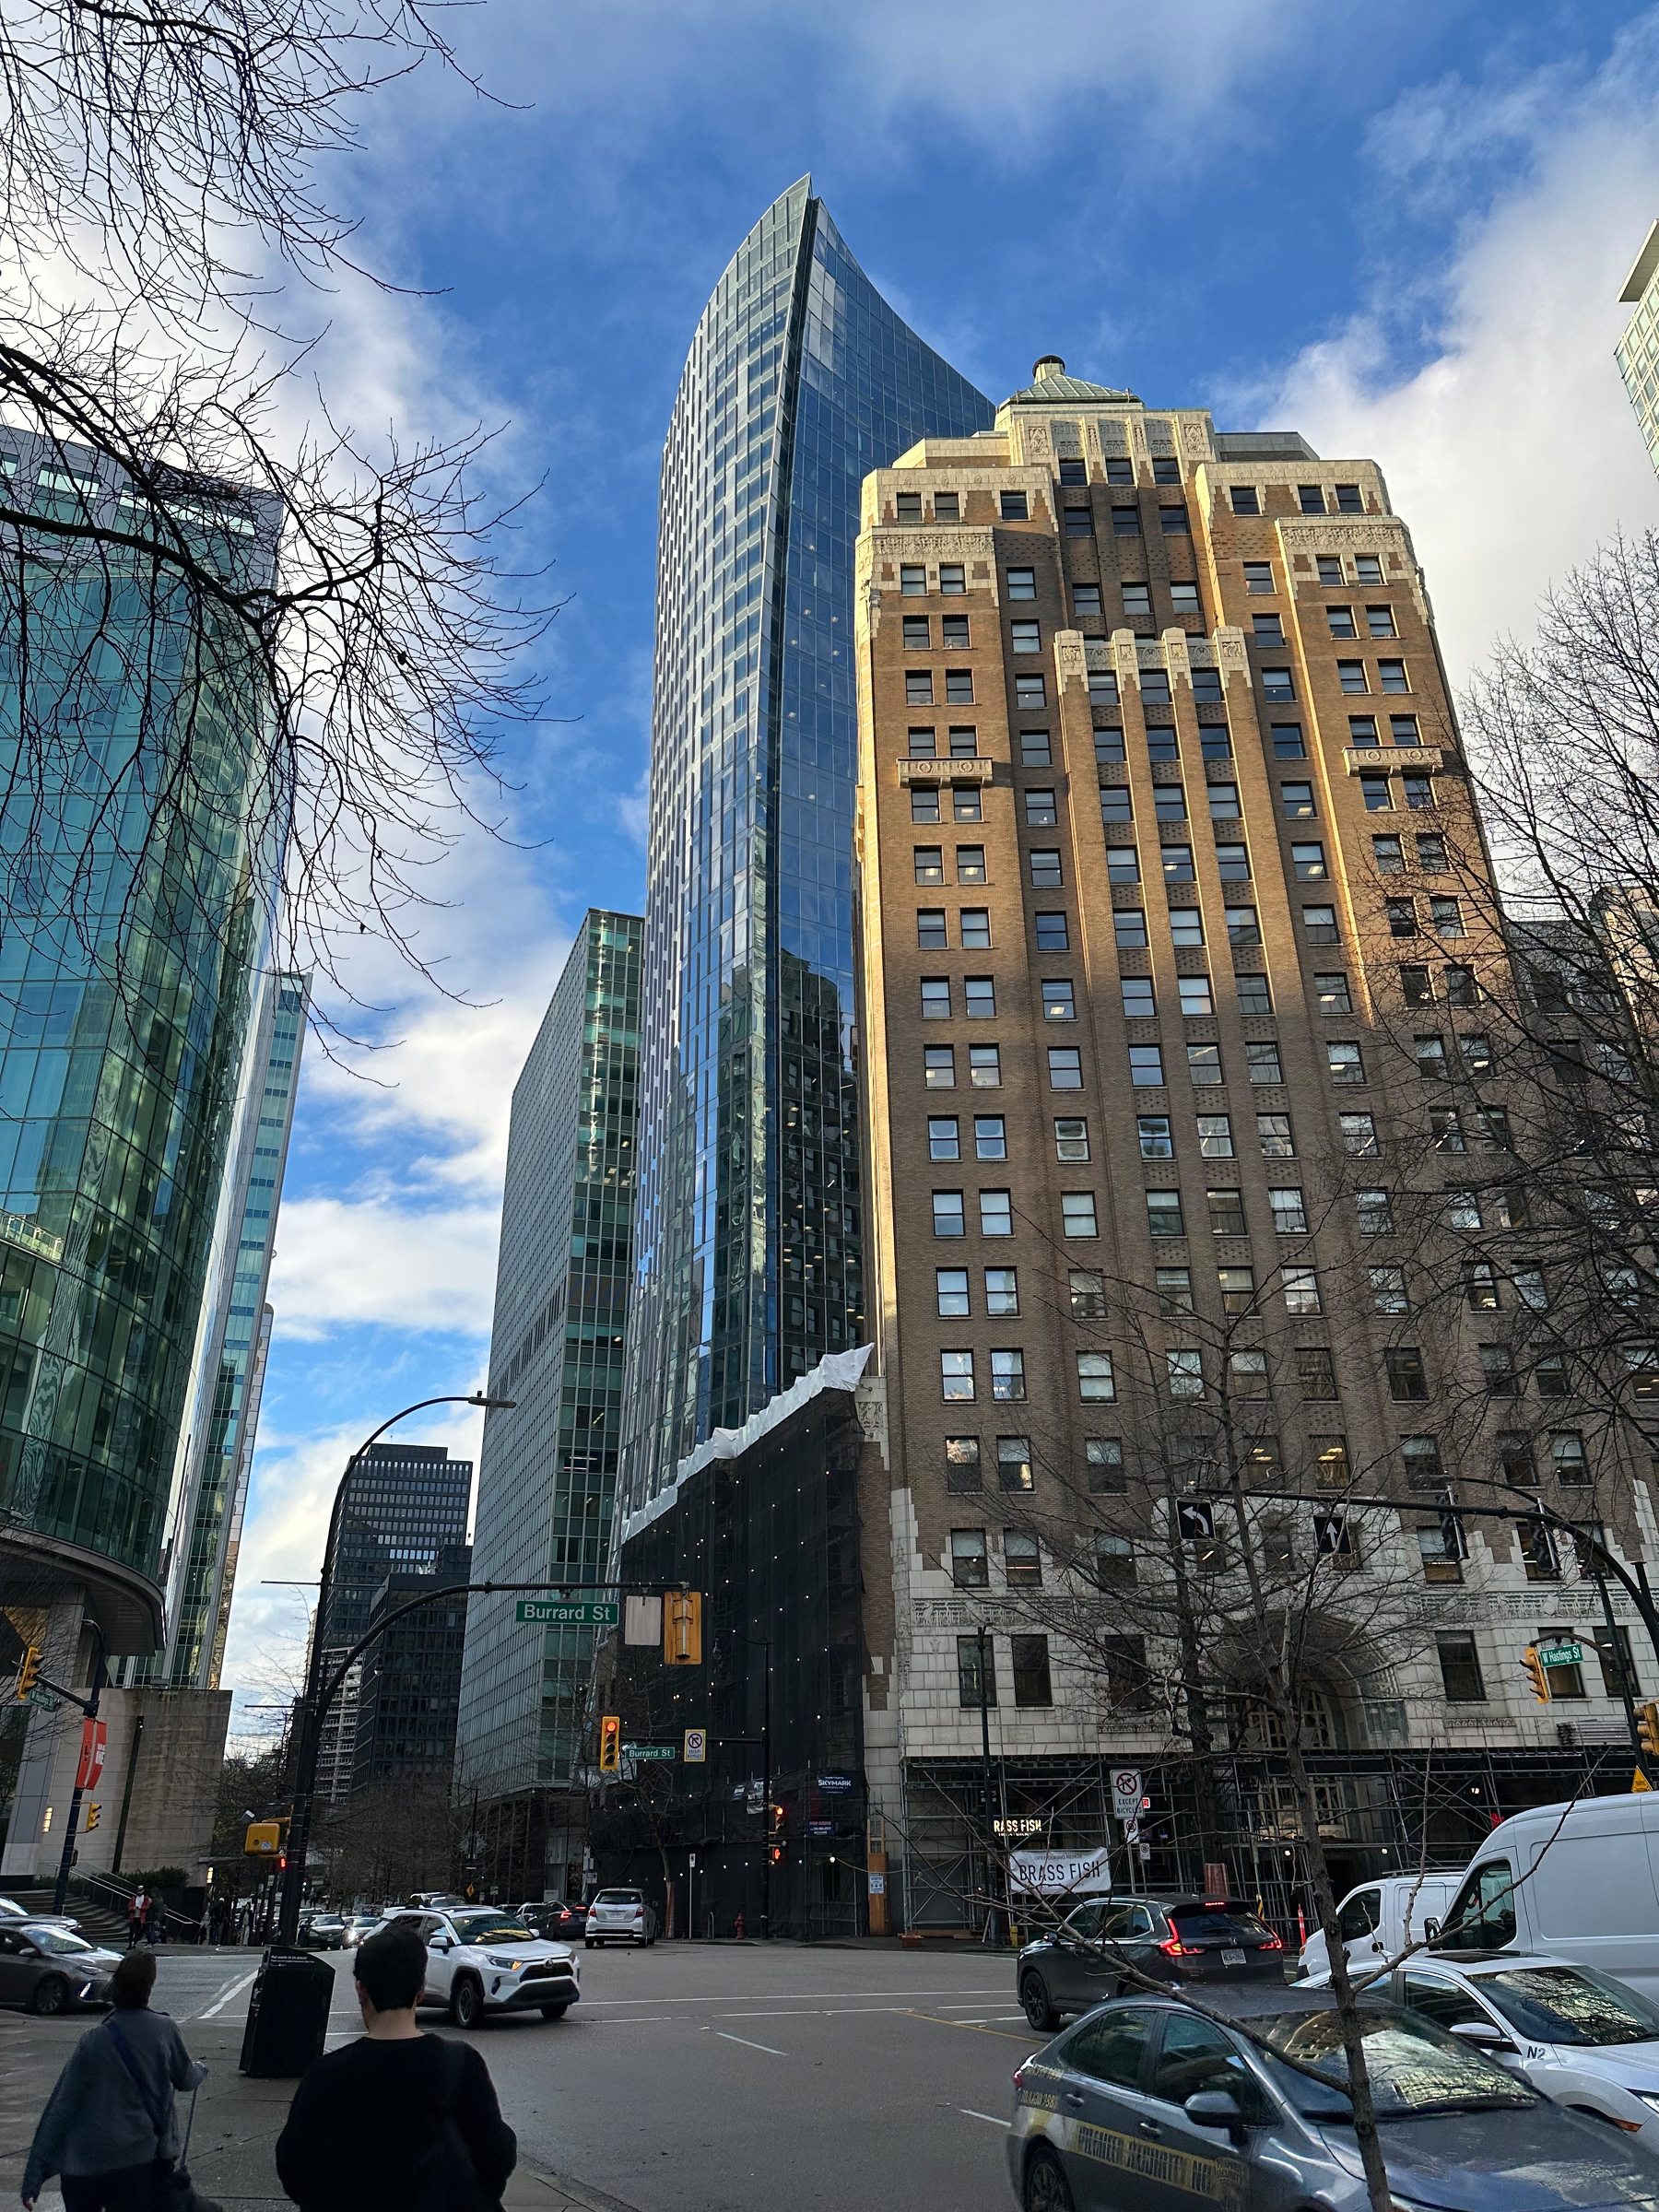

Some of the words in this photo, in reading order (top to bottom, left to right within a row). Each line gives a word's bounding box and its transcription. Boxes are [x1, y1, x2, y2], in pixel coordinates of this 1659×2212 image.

[524, 1604, 585, 1620] Burrard
[592, 1606, 610, 1620] St
[1541, 1652, 1548, 1664] W
[1548, 1650, 1572, 1663] Hastings
[1572, 1646, 1581, 1659] St
[629, 1749, 659, 1758] Burrard
[818, 1779, 852, 1787] SKYMARK
[1118, 1797, 1138, 1806] EXCEPT
[1020, 1819, 1041, 1832] FISH
[1019, 1864, 1065, 1881] BRASS
[1069, 1861, 1100, 1879] FISH
[1526, 2045, 1547, 2061] N2
